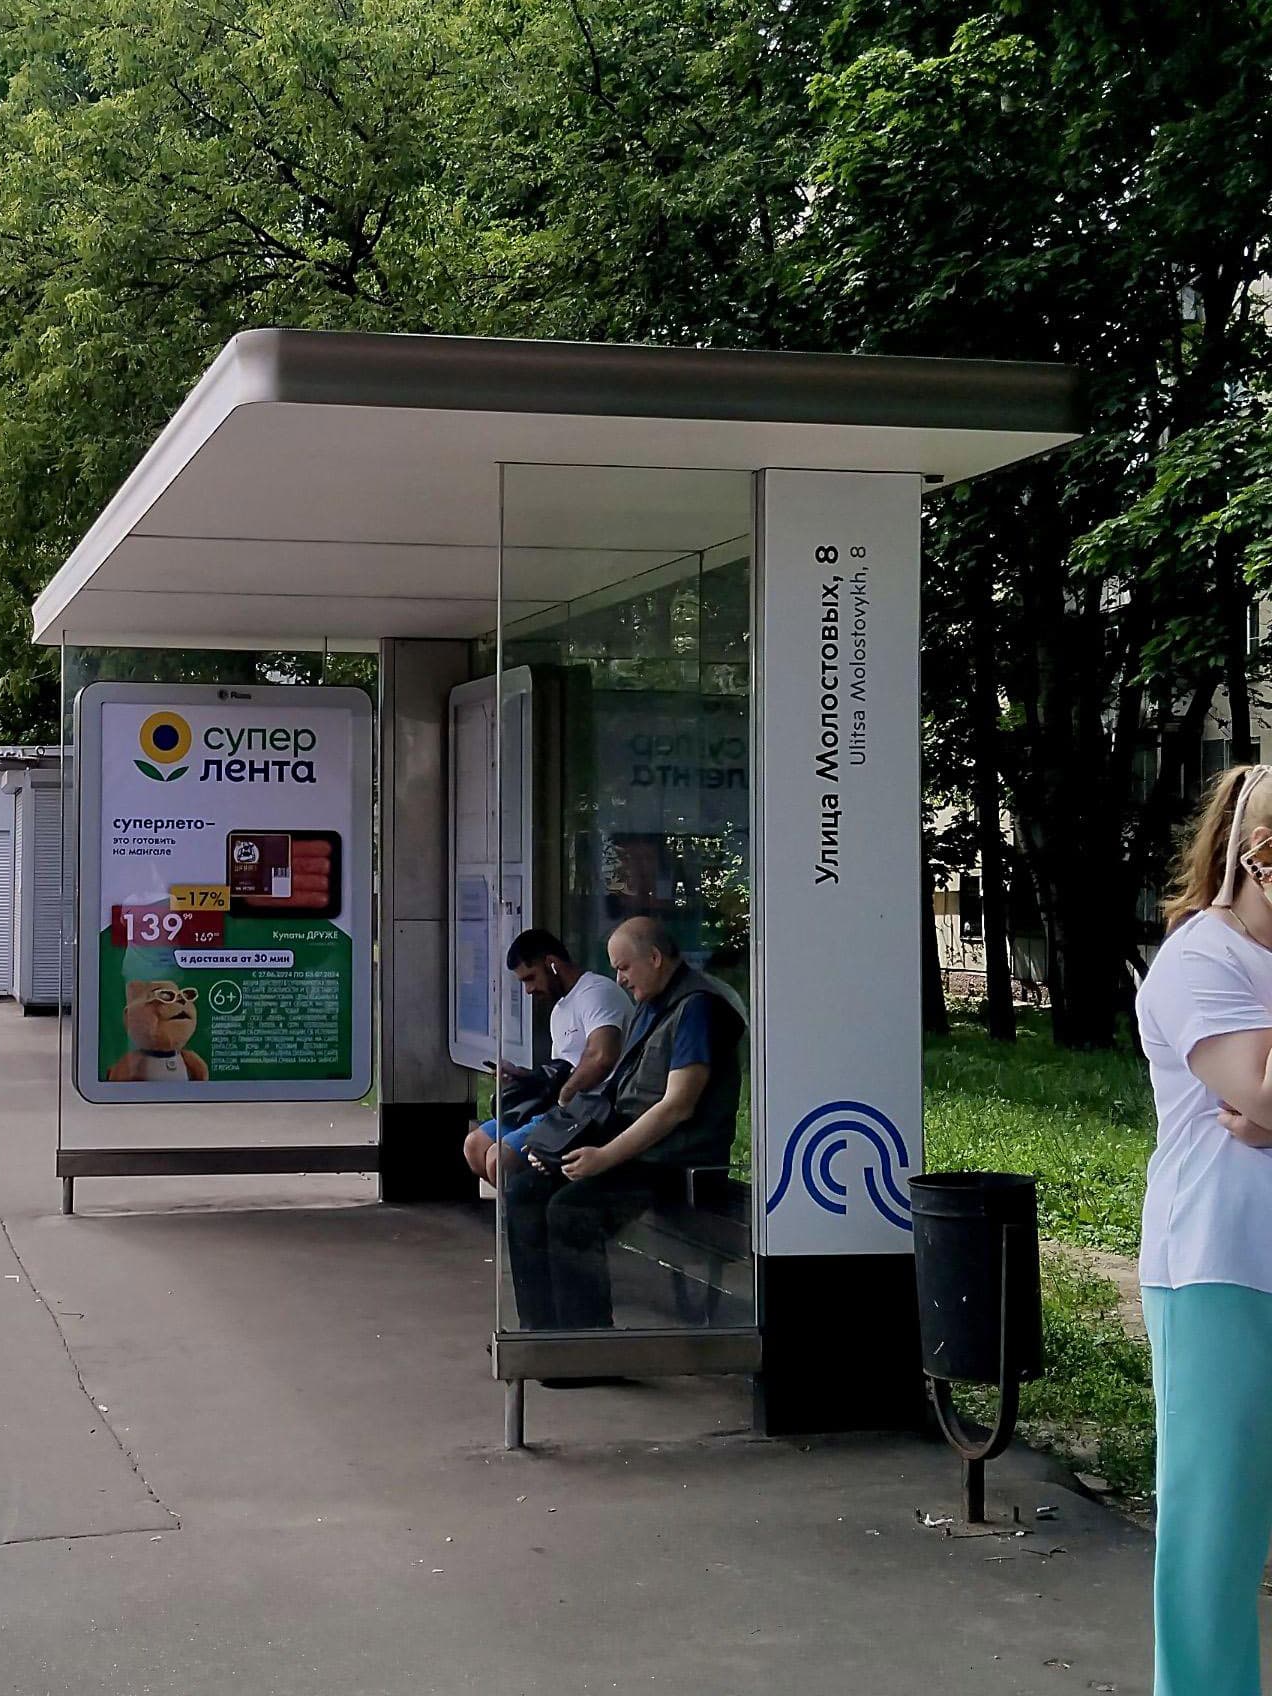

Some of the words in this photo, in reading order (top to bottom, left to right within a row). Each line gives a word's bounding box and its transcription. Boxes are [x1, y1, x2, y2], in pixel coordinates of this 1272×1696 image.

[814, 544, 840, 565] 8
[849, 545, 867, 558] 8
[849, 566, 870, 702] Molostovykh,
[814, 574, 844, 783] Молостовых,
[203, 726, 317, 758] супер
[849, 710, 867, 766] Ulitsa
[199, 759, 317, 784] лента
[112, 837, 130, 845] это
[132, 837, 177, 845] готовить
[814, 793, 842, 885] Улица
[112, 848, 126, 856] на
[128, 848, 172, 856] мангале
[176, 891, 225, 907] -17%
[122, 913, 183, 941] 139
[272, 930, 305, 942] Купаты
[306, 930, 338, 941] ДРУЖЕ
[189, 956, 239, 964] доставка
[254, 954, 267, 963] 30
[213, 989, 237, 1005] 6+
